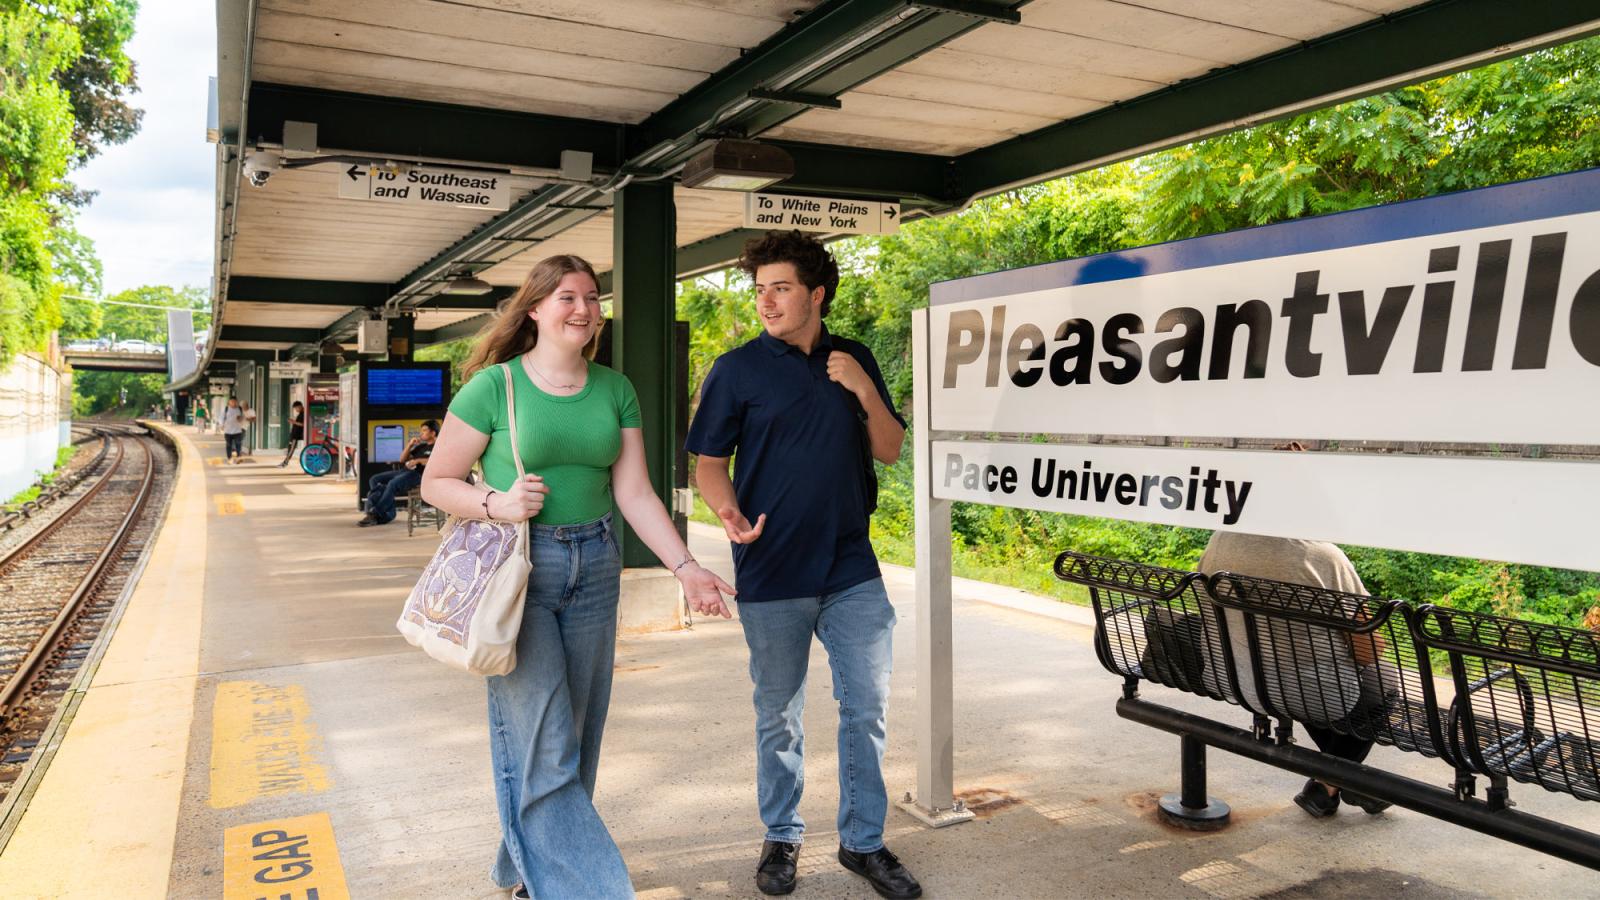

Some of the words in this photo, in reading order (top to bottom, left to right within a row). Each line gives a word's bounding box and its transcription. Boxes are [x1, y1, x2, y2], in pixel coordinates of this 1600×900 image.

[407, 170, 498, 190] Southeast
[374, 186, 410, 199] and
[420, 187, 490, 205] Wassaic
[758, 196, 773, 209] To
[782, 198, 821, 212] White
[828, 202, 869, 216] Plains
[756, 212, 784, 224] and
[790, 214, 821, 227] New
[829, 216, 857, 228] York
[944, 453, 1018, 495] Pace
[1031, 458, 1253, 526] University
[252, 829, 314, 884] GAP
